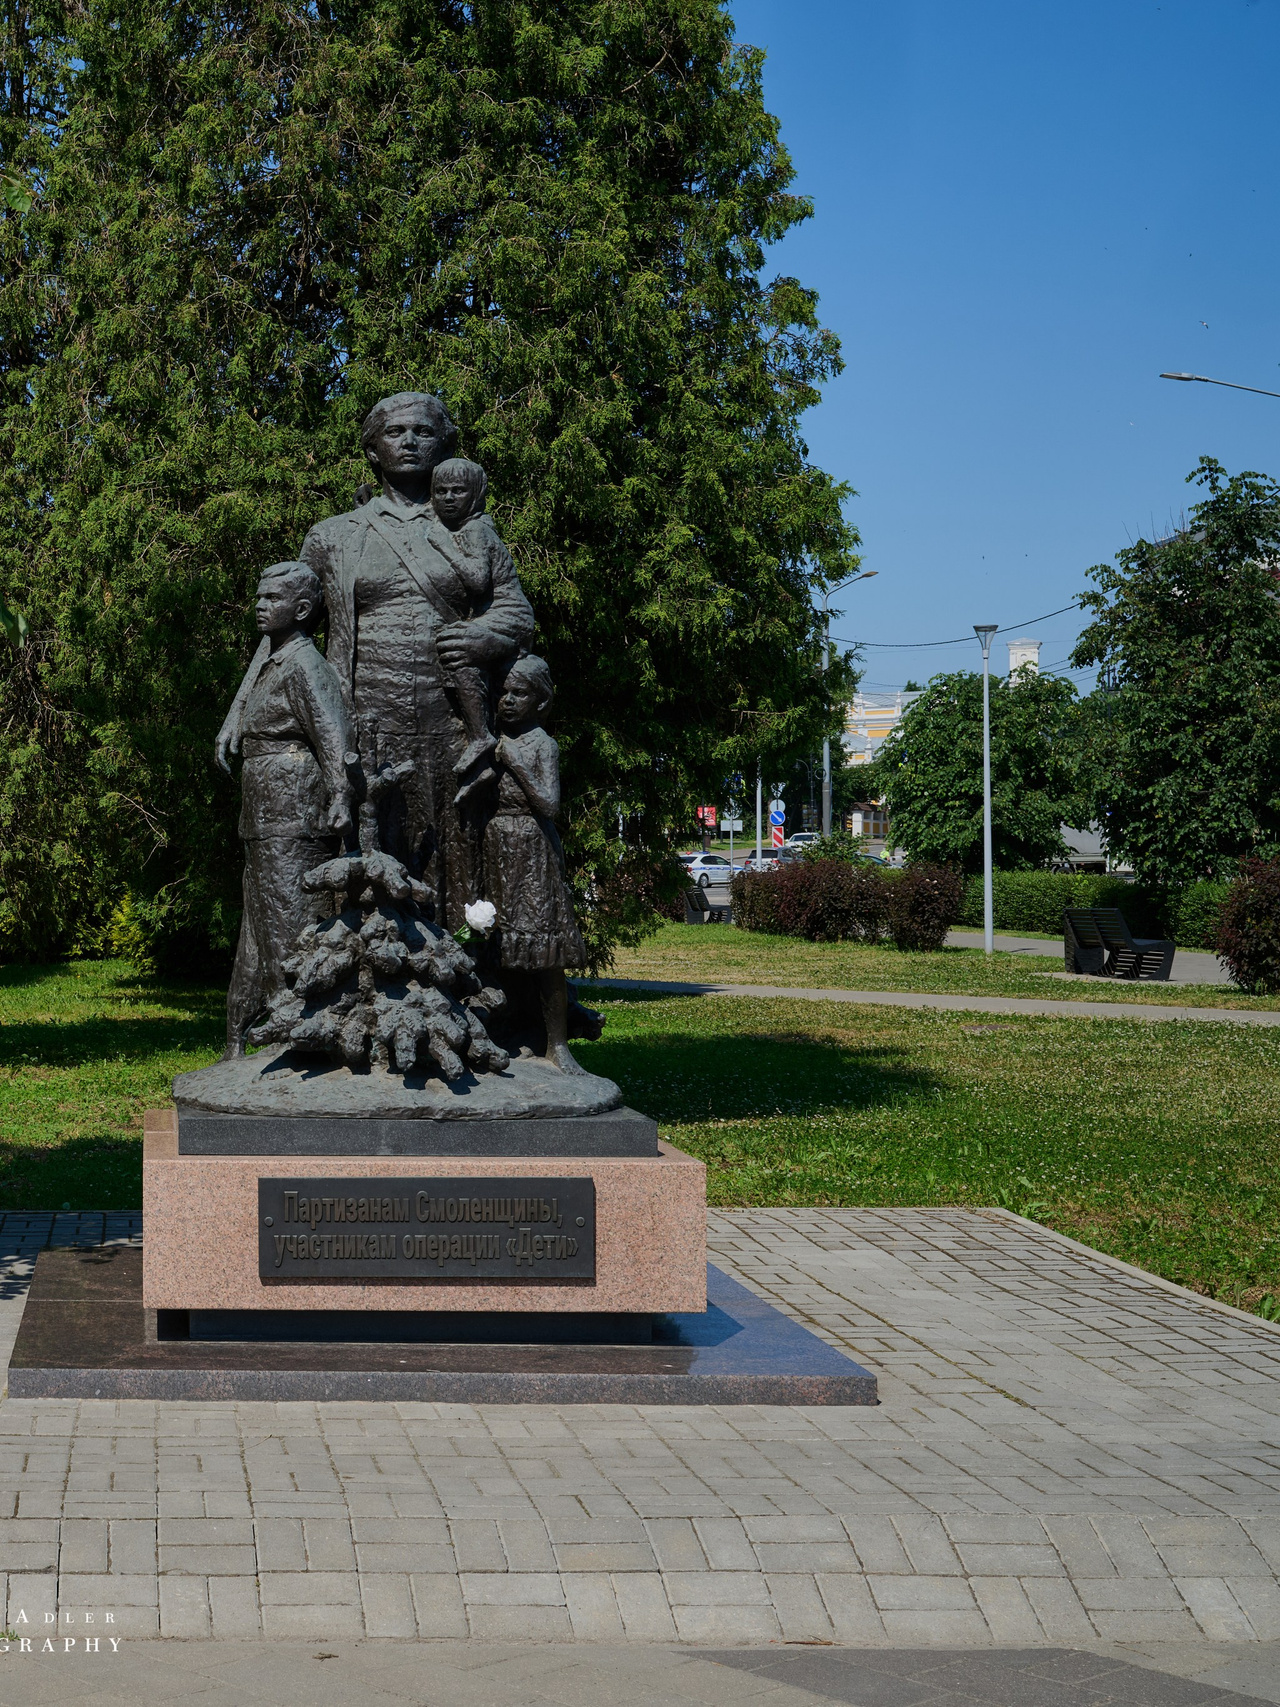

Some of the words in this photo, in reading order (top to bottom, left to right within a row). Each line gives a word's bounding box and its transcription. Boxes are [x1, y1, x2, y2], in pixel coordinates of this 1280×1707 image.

[284, 1191, 410, 1230] Партизанам
[416, 1190, 562, 1228] Смоленщины,
[274, 1234, 396, 1268] участникам
[402, 1234, 500, 1267] операции
[506, 1228, 578, 1266] «Дети»
